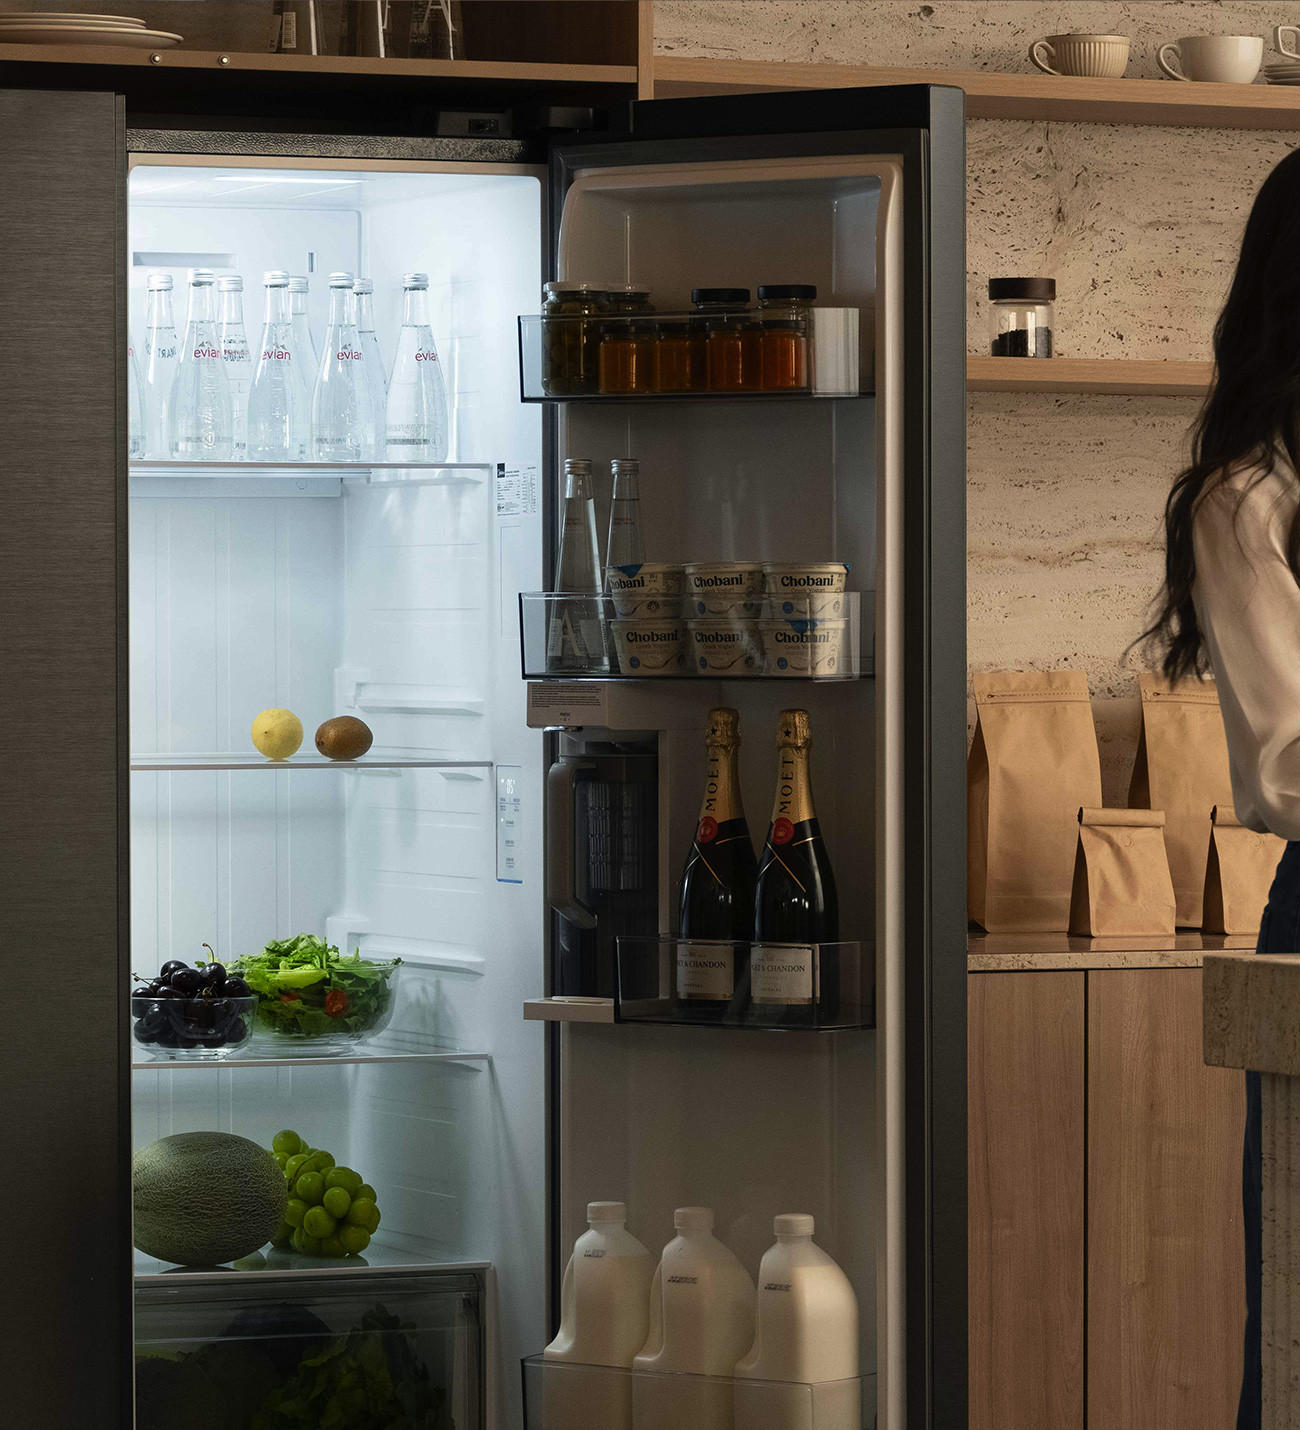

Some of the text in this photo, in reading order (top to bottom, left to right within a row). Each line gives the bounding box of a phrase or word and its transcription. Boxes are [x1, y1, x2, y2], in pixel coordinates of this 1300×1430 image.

[610, 576, 645, 589] hobani
[694, 573, 743, 588] Chobani
[781, 574, 834, 587] Chobani
[626, 629, 678, 643] Chobani
[694, 630, 744, 643] Chobani
[775, 631, 829, 643] Chobani
[689, 959, 727, 970] CHANDON
[767, 963, 806, 973] CHANDON
